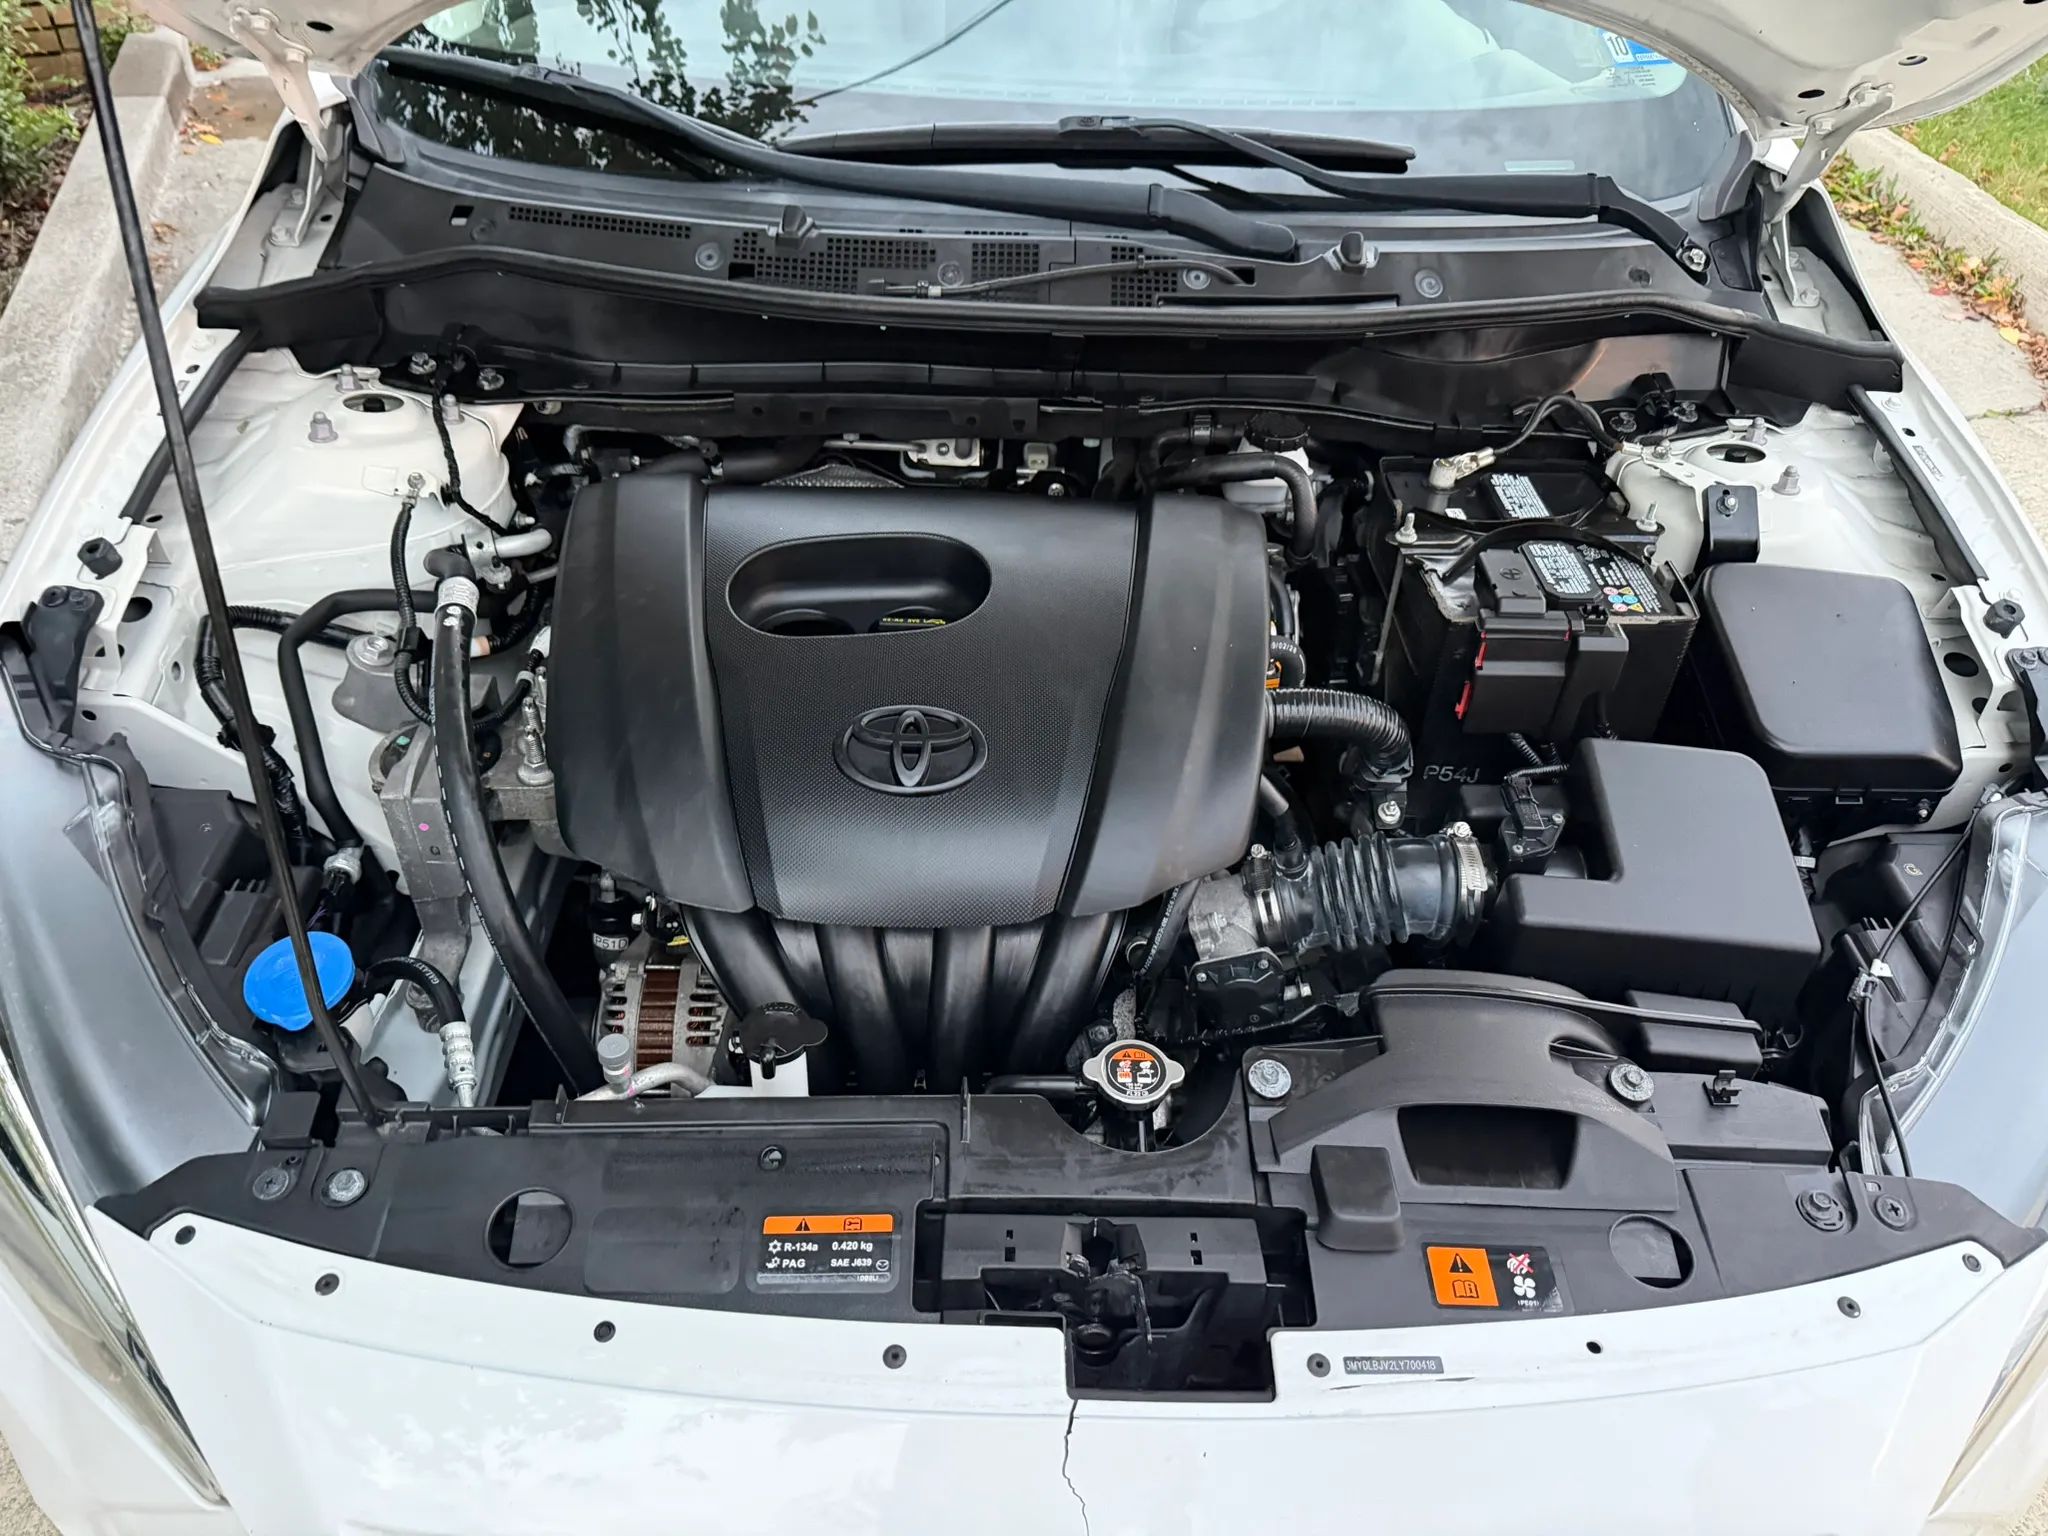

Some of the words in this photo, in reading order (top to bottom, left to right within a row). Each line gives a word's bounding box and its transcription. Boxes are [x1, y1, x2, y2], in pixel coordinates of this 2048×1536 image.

[1606, 35, 1629, 56] 10
[1423, 765, 1480, 783] P54J
[784, 1242, 818, 1252] R-134a
[832, 1241, 858, 1250] 0.420
[860, 1241, 873, 1252] kg
[782, 1258, 806, 1268] PAG
[830, 1258, 850, 1267] SAE
